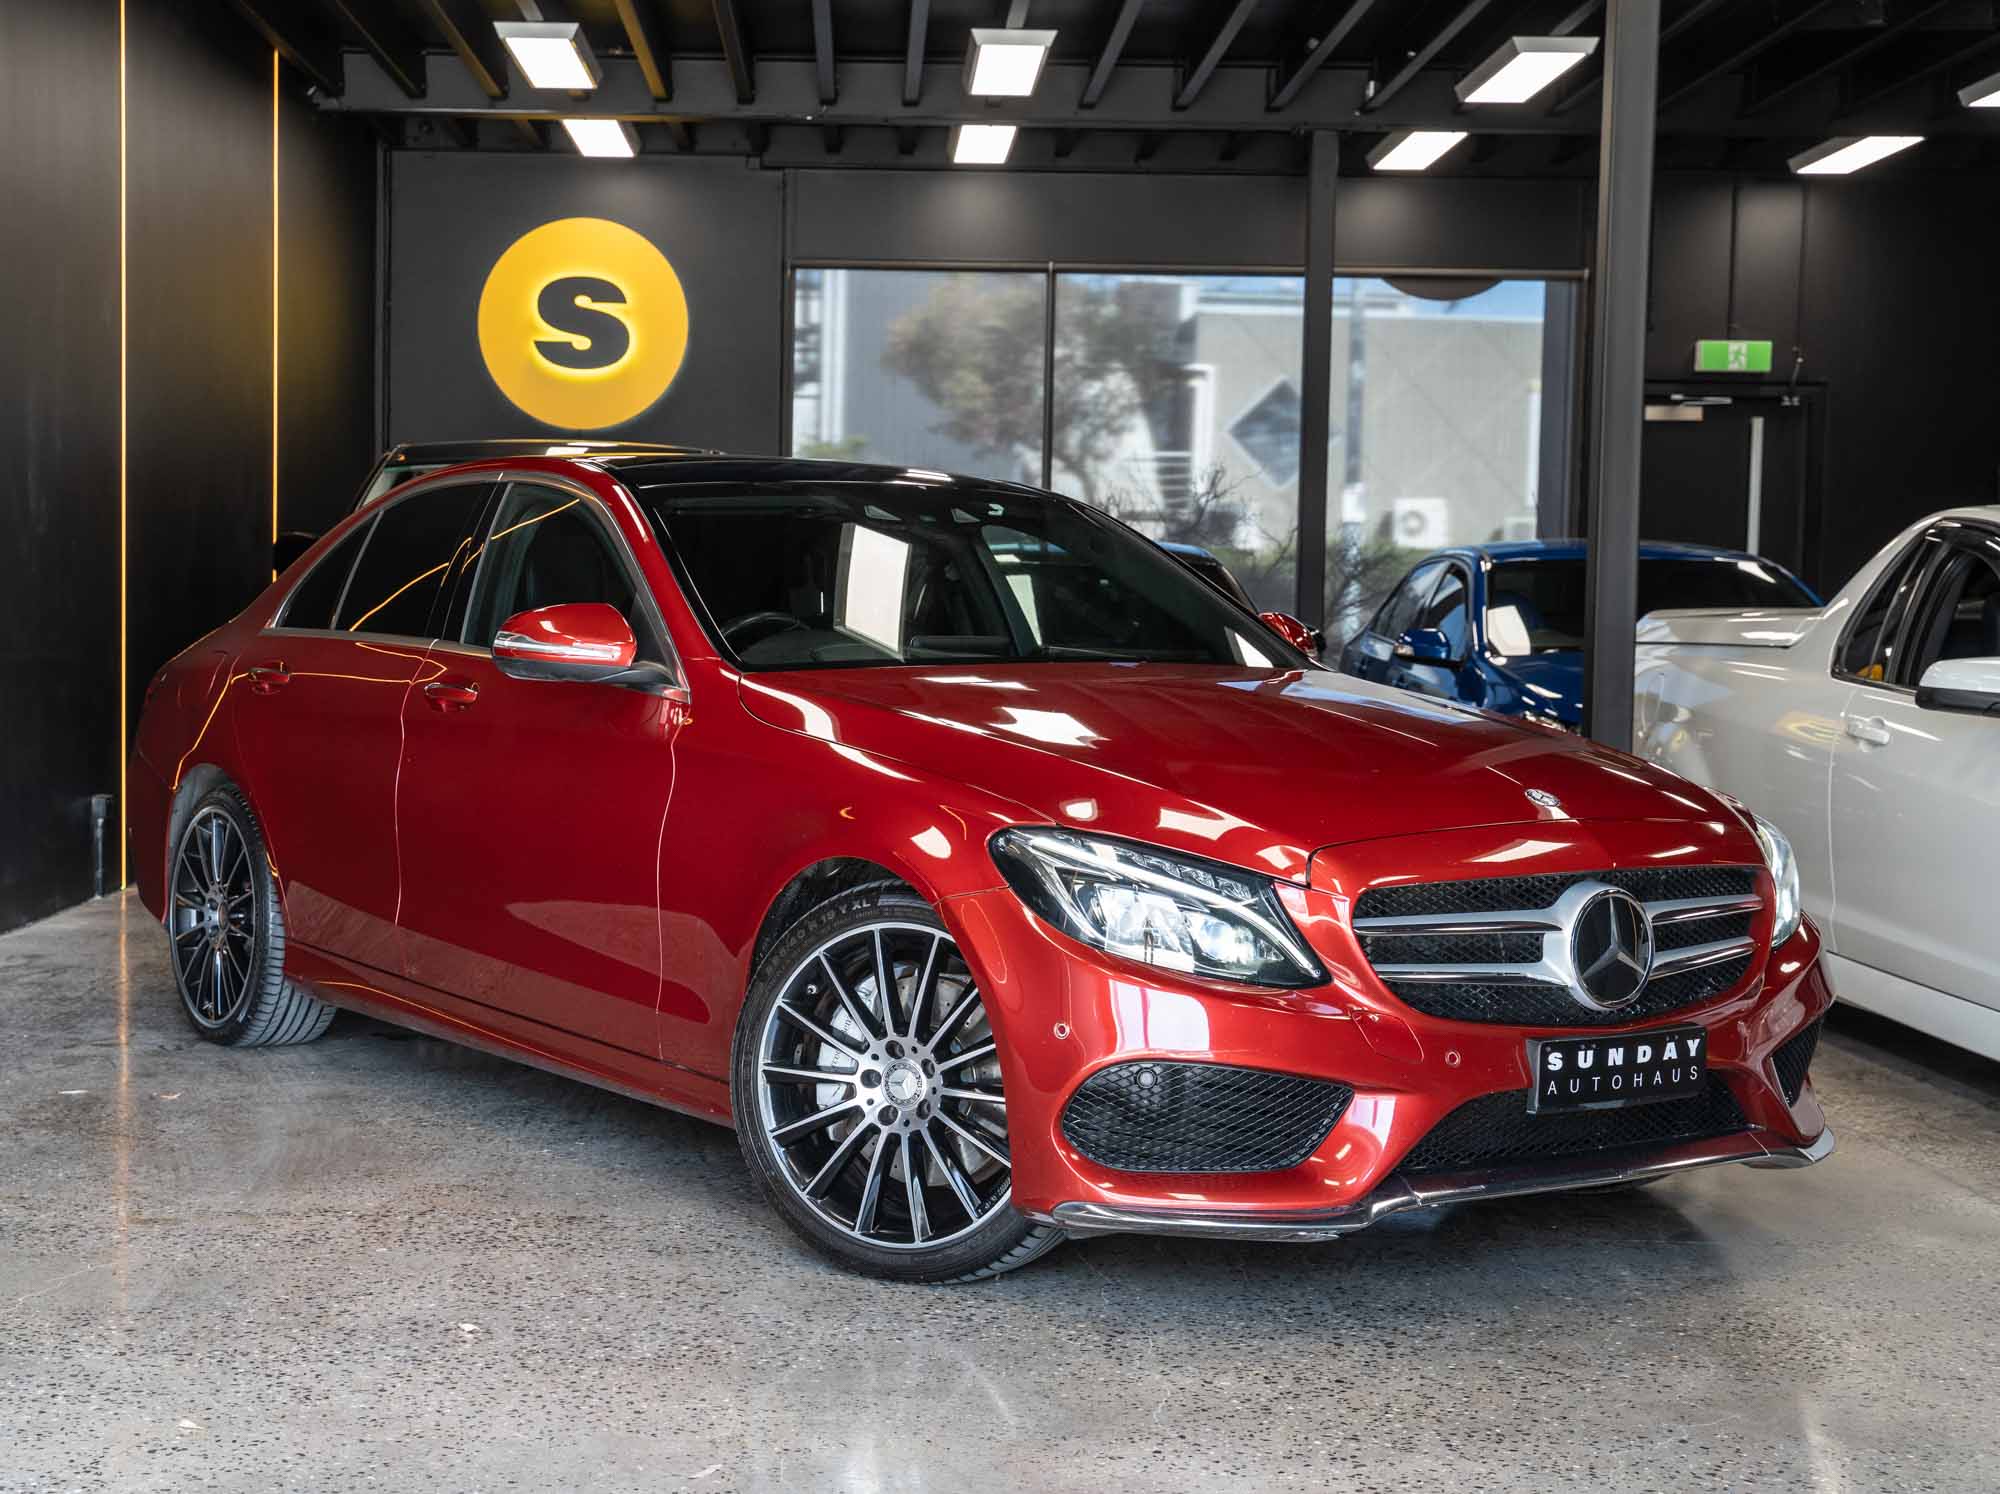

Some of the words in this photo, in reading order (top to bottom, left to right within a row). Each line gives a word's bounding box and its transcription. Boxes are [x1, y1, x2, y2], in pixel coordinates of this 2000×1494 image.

[534, 276, 630, 370] S
[852, 898, 871, 910] XL
[1547, 1065, 1698, 1096] AUTOHAUS
